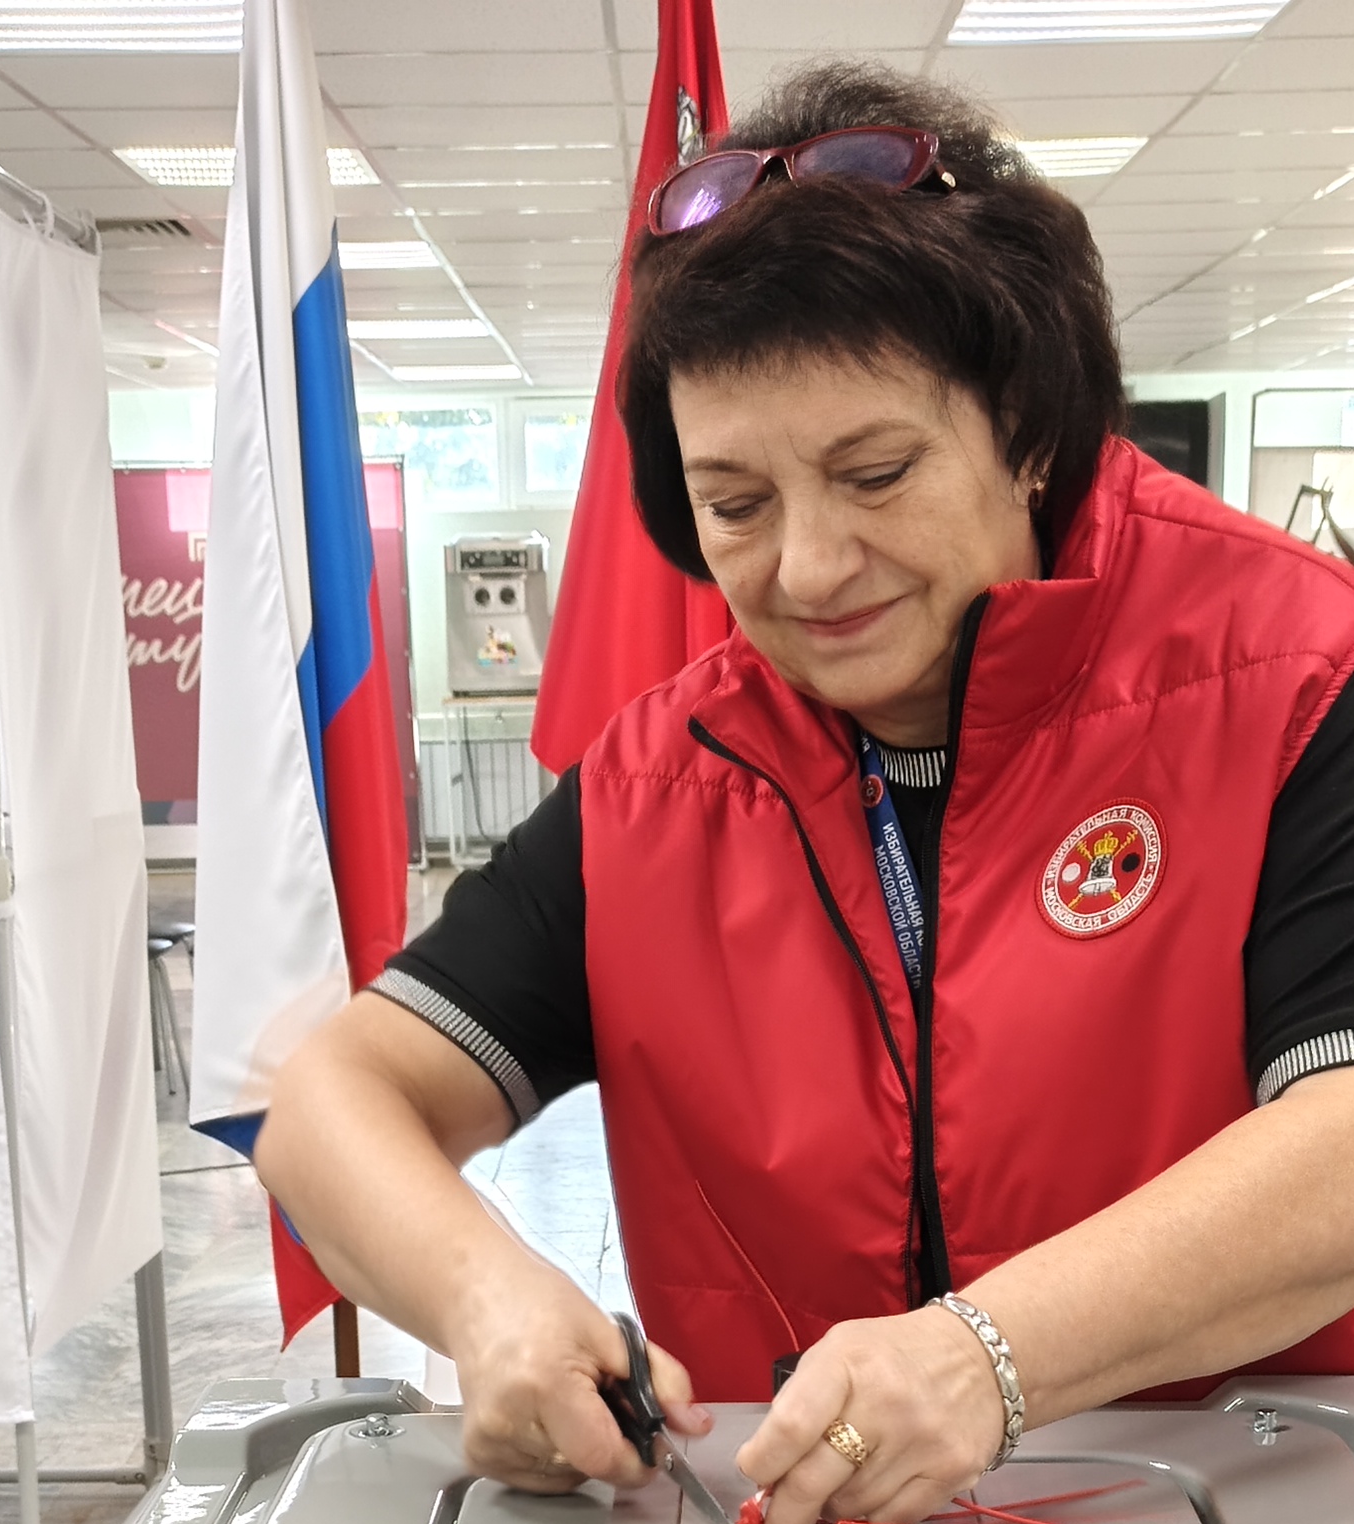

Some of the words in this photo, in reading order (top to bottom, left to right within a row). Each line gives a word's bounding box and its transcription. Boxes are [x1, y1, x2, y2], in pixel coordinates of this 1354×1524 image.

[1131, 809, 1158, 863] КОМИССИЯ
[874, 844, 911, 931] МОСКОВСКОЙ
[882, 821, 924, 927] ИЗБИРАТЕЛЬНАЯ
[1044, 886, 1102, 929] МОСКОВСКАЯ
[1107, 873, 1154, 921] ОБЛАСТЬ
